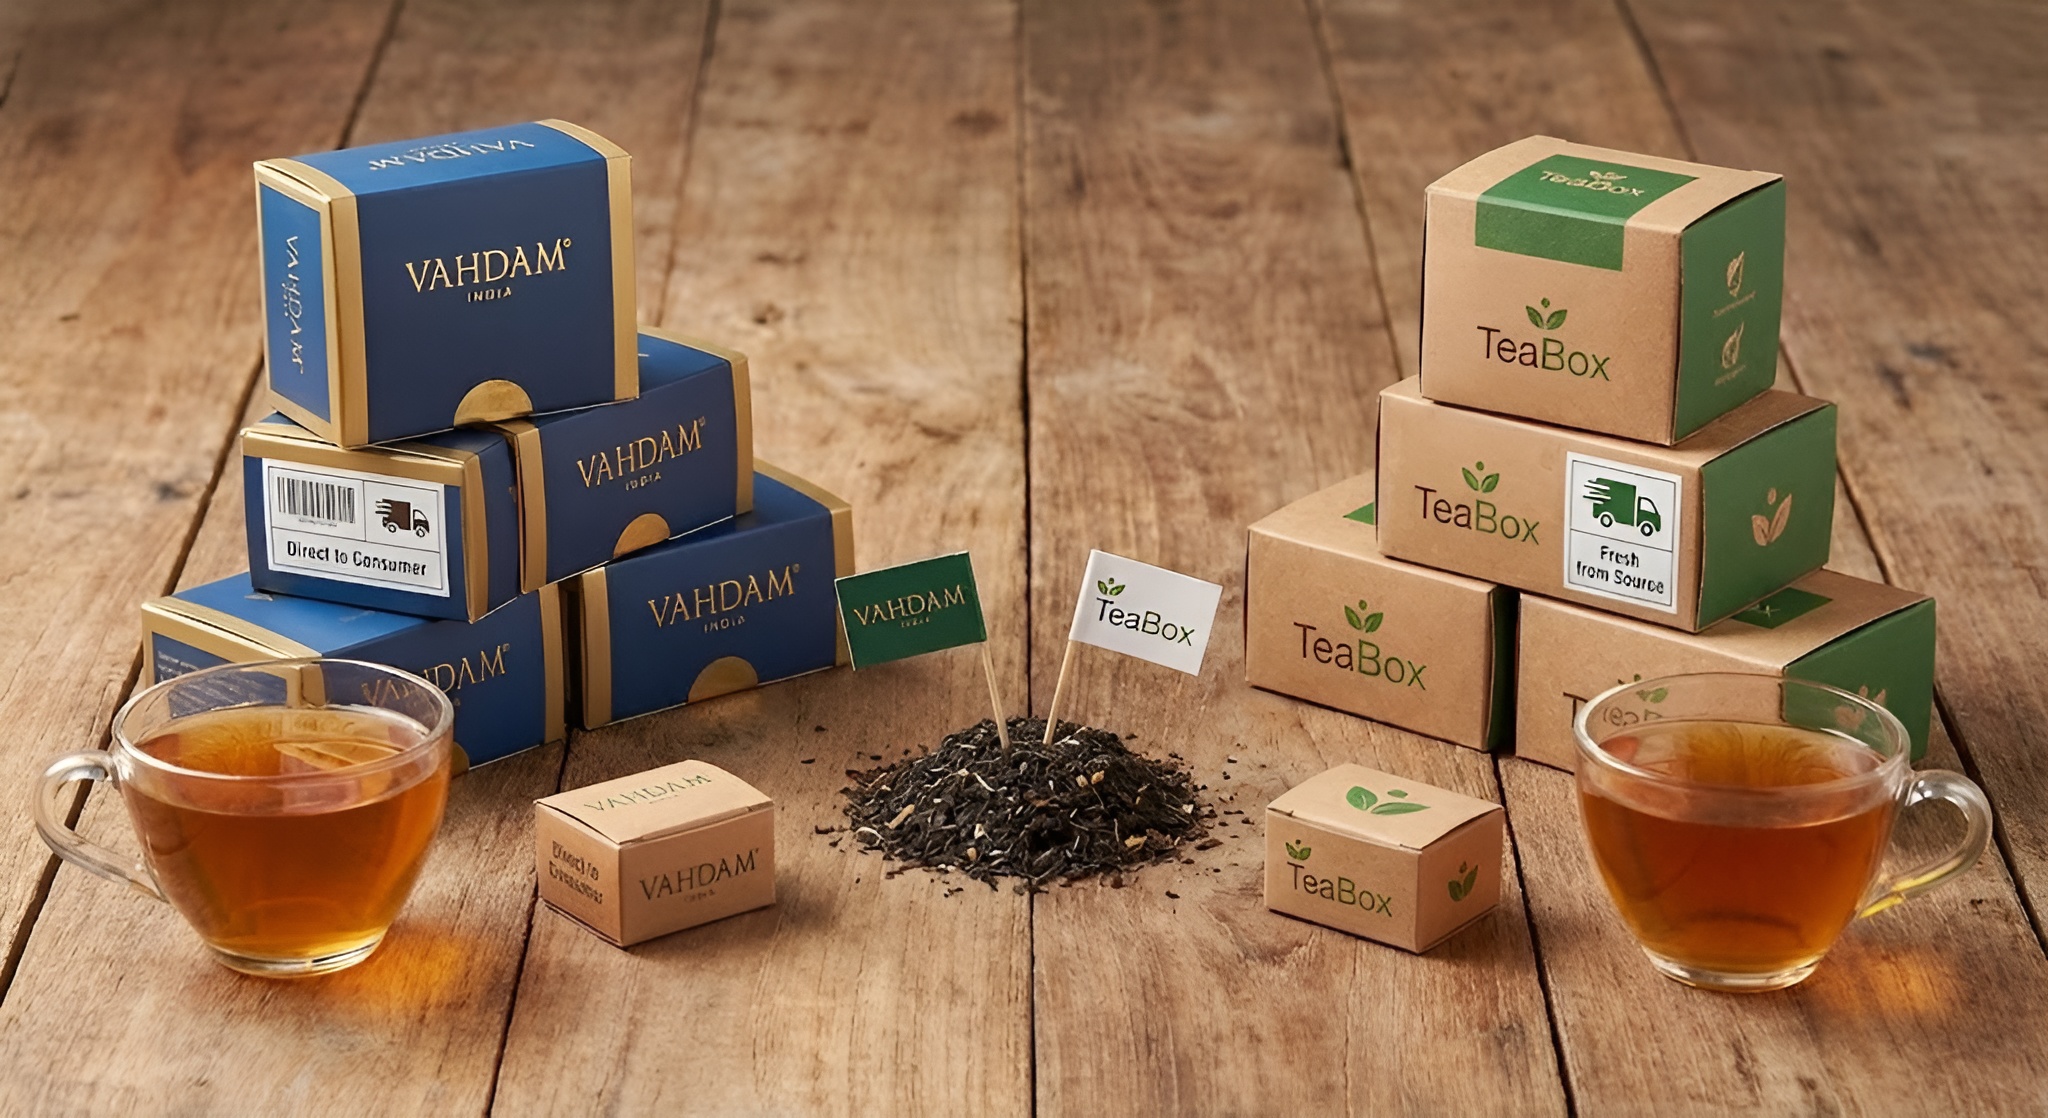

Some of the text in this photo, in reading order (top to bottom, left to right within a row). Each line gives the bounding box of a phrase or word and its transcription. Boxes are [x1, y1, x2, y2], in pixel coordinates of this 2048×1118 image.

[1477, 325, 1612, 382] TeaBox
[1414, 485, 1540, 546] TeaBox
[287, 540, 427, 576] Direct to Consumer
[1576, 560, 1664, 595] from Source
[1600, 545, 1640, 568] Fresh
[853, 584, 966, 626] VAHDAM
[1096, 596, 1195, 647] TeaBox
[1293, 621, 1427, 691] TeaBox
[1286, 861, 1393, 918] TeaBox
